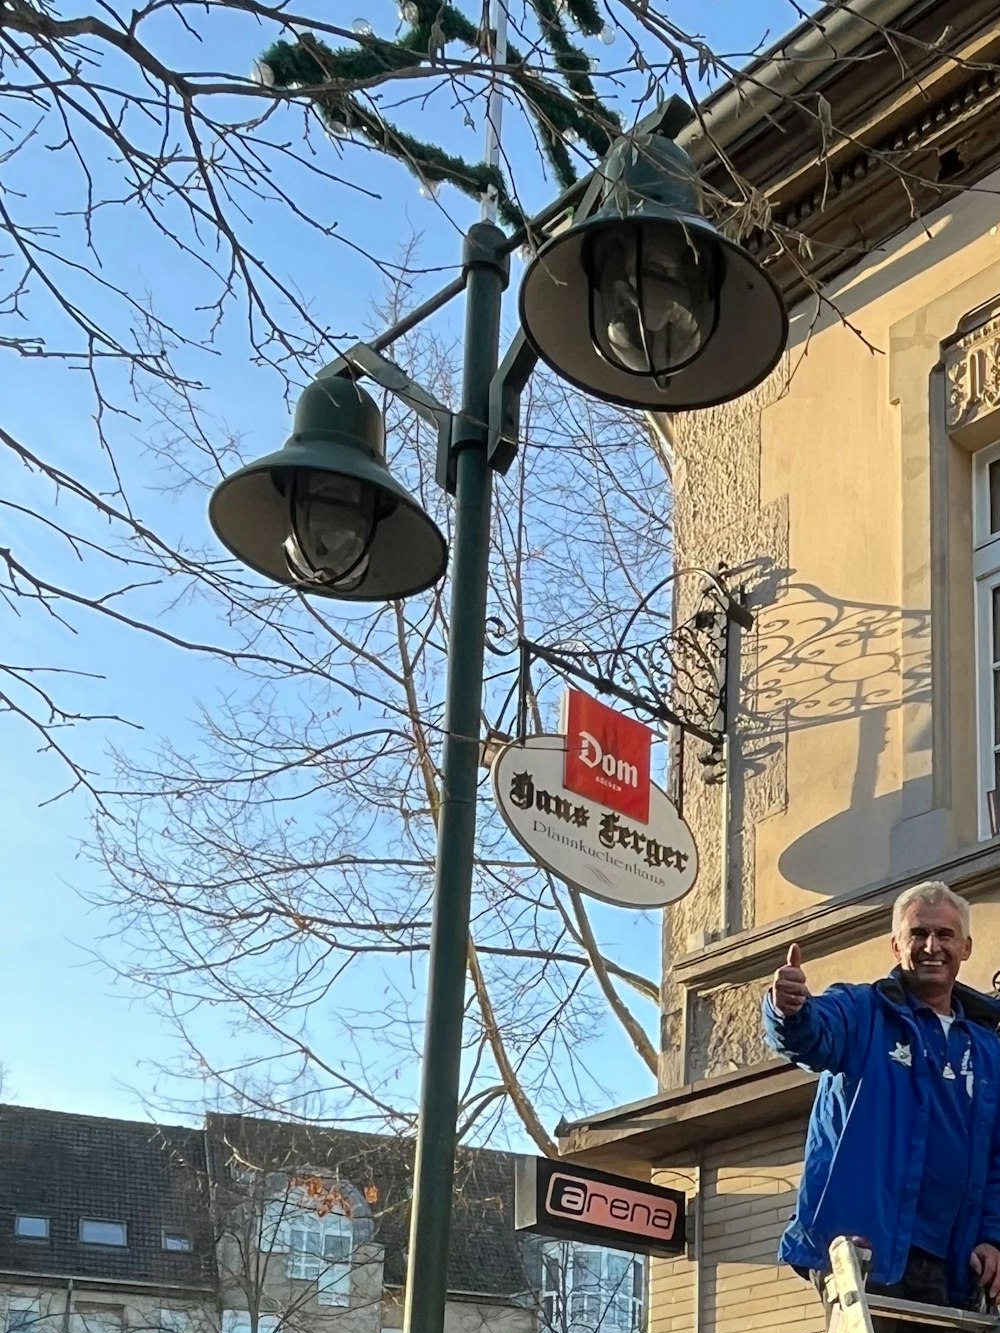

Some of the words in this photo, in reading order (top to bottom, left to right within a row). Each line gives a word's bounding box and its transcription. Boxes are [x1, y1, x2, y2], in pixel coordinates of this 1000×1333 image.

[578, 730, 638, 789] Dom
[509, 769, 591, 829] Haus
[598, 811, 690, 875] Ferger
[532, 819, 667, 888] Pfannkuchenhaus
[559, 1184, 673, 1230] arena
